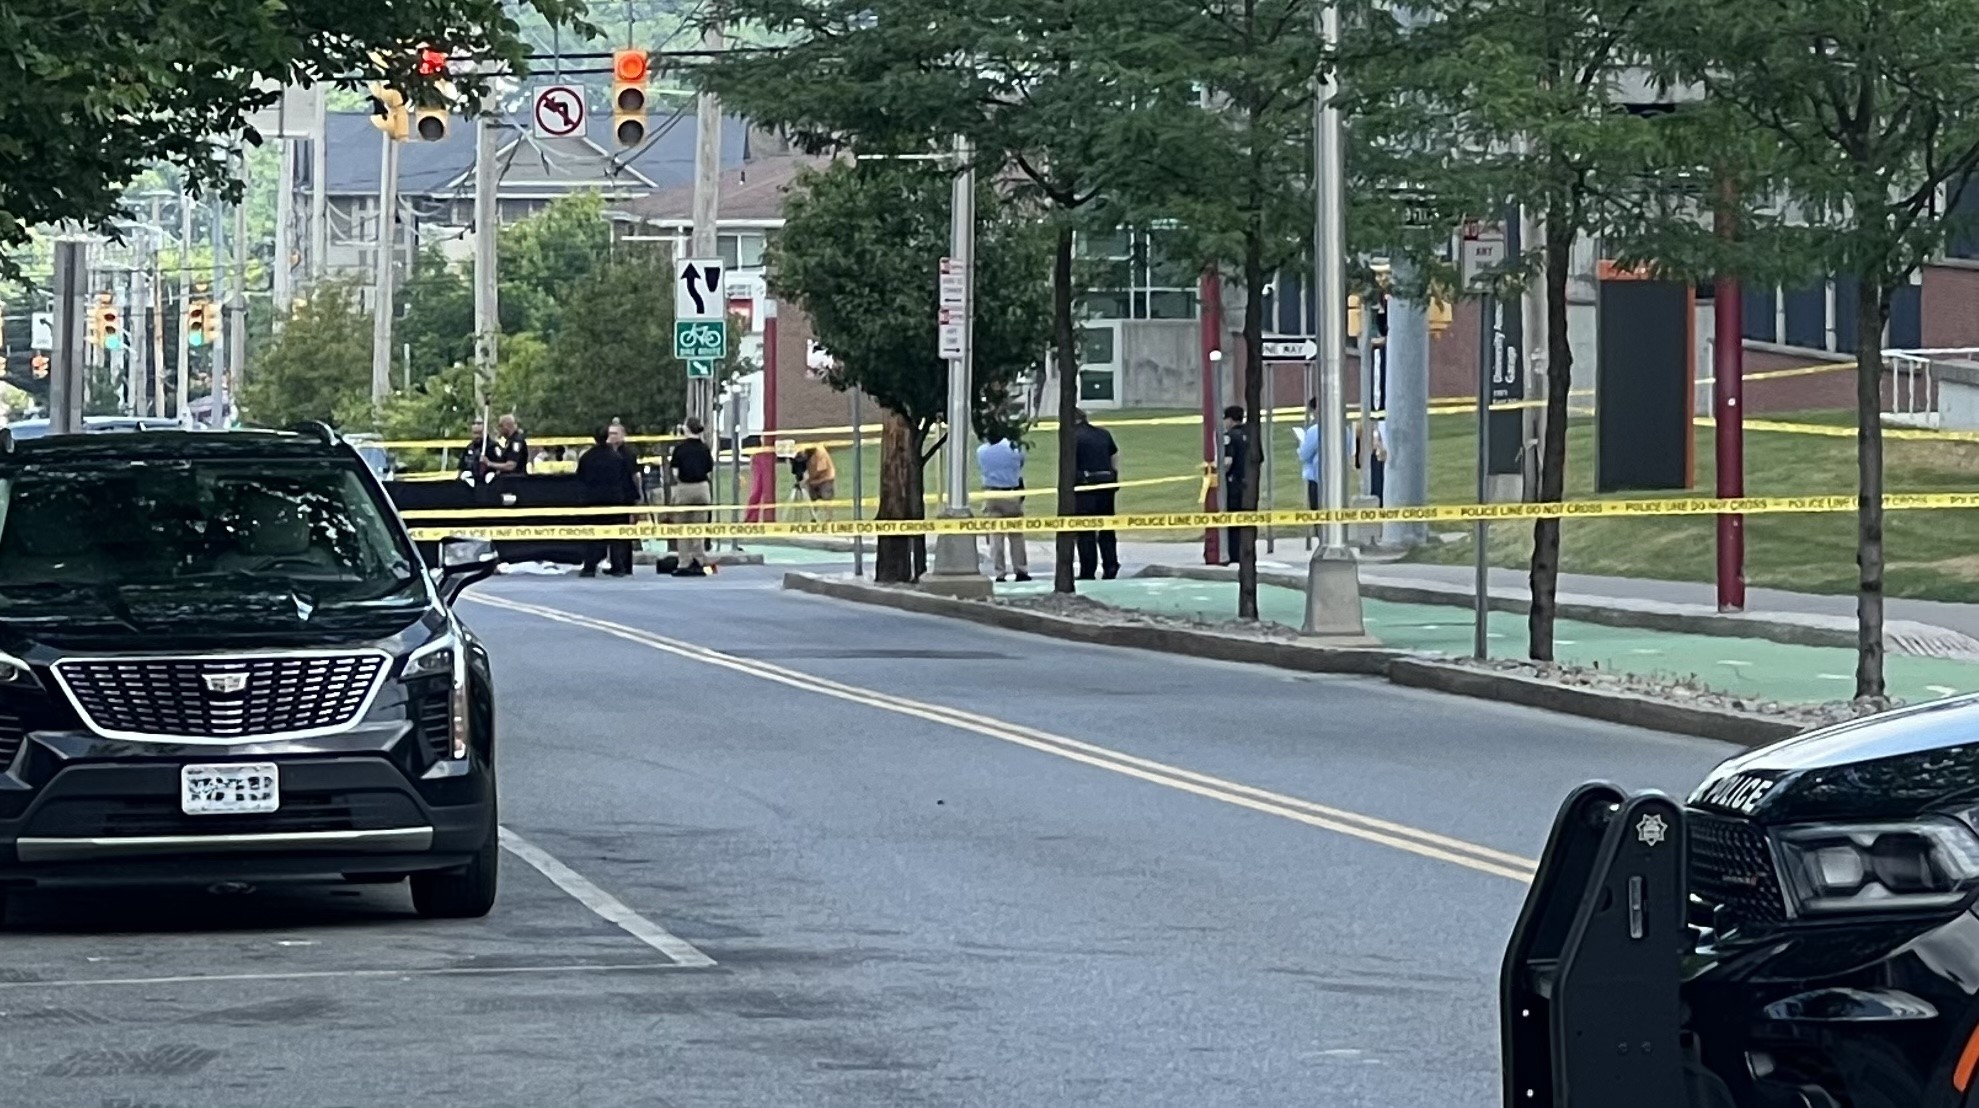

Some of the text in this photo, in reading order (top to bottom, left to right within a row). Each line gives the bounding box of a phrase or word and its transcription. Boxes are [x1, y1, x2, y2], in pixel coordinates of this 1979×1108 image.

[1460, 503, 1603, 517] POLICE LINE DO NOT CROSS
[1625, 500, 1768, 512] POLICE LINE DO NOT CROSS
[1788, 498, 1825, 509] POLICE
[1127, 512, 1272, 526] POLICE LINE DO NOT CROSS
[1295, 508, 1438, 522] POLICE LINE DO NOT CROSS
[619, 524, 766, 537] POLICE LINE DO NOT CROSS
[789, 521, 936, 534] POLICE LINE DO NOT CROSS
[959, 518, 1104, 531] POLICE LINE DO NOT CROSS
[490, 527, 512, 538] LINE
[515, 527, 531, 538] DO
[533, 526, 555, 538] NOT
[558, 526, 596, 538] CROSS
[1703, 776, 1774, 813] POLICE
